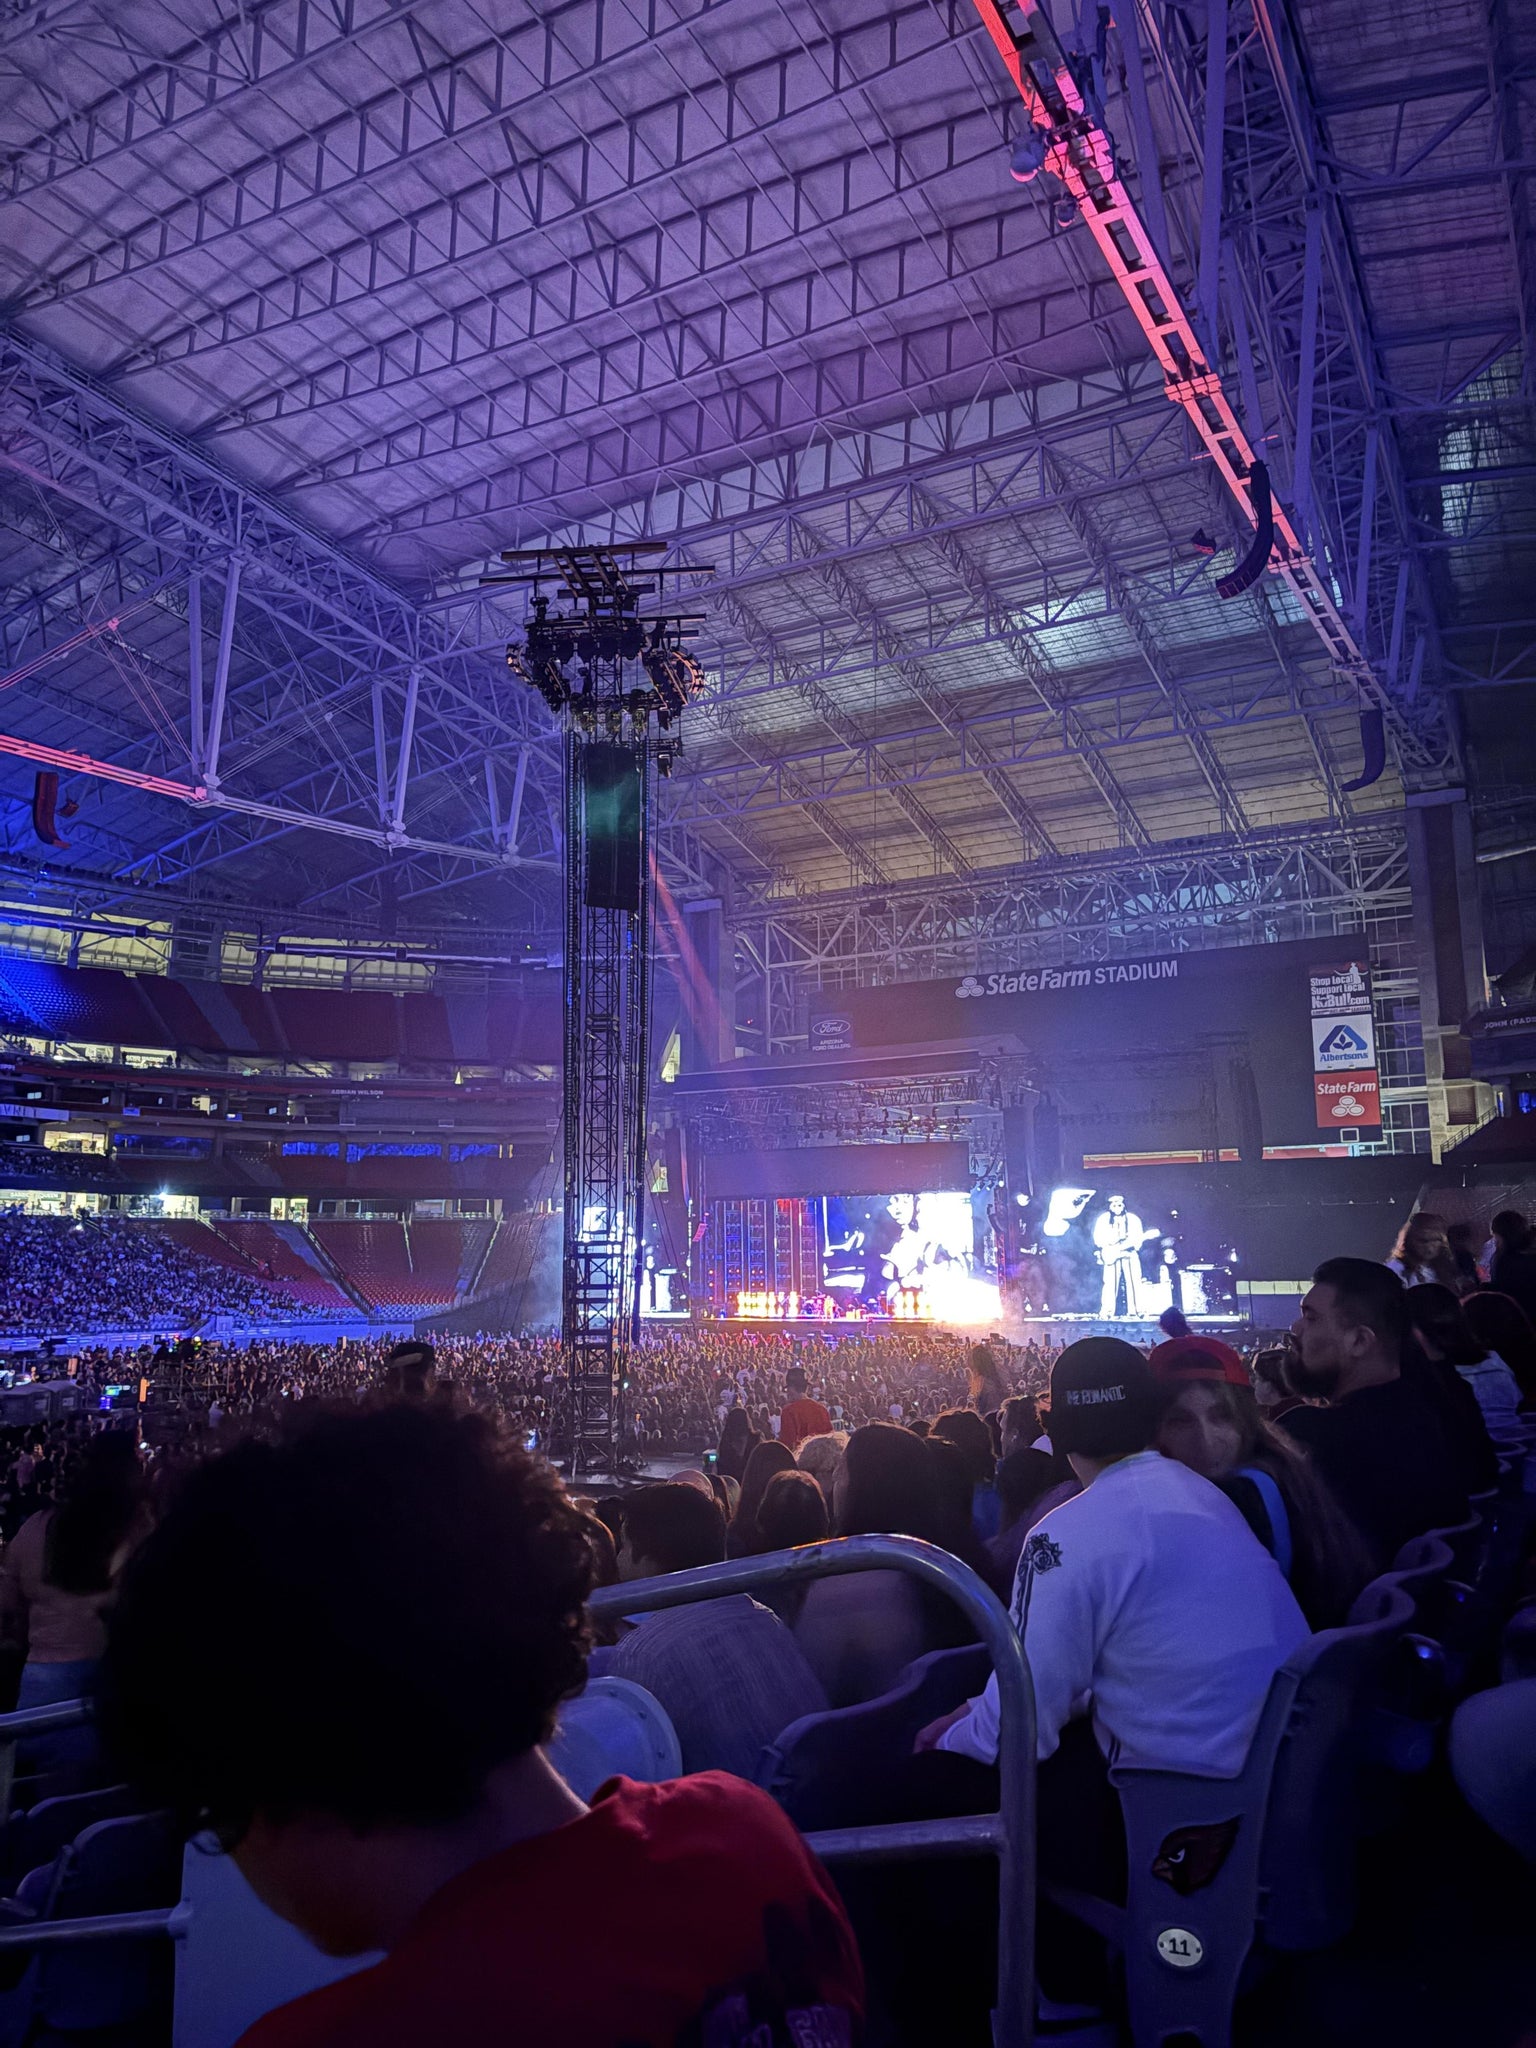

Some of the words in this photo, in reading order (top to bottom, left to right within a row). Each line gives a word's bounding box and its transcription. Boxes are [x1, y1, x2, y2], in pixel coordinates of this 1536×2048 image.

[1094, 960, 1178, 984] STADIUM
[1310, 977, 1331, 987] Shop
[1332, 974, 1353, 985] Local
[1310, 984, 1343, 995] Support
[1343, 982, 1365, 993] Local
[1320, 1052, 1369, 1062] Albertsons
[1169, 1937, 1191, 1956] 11
